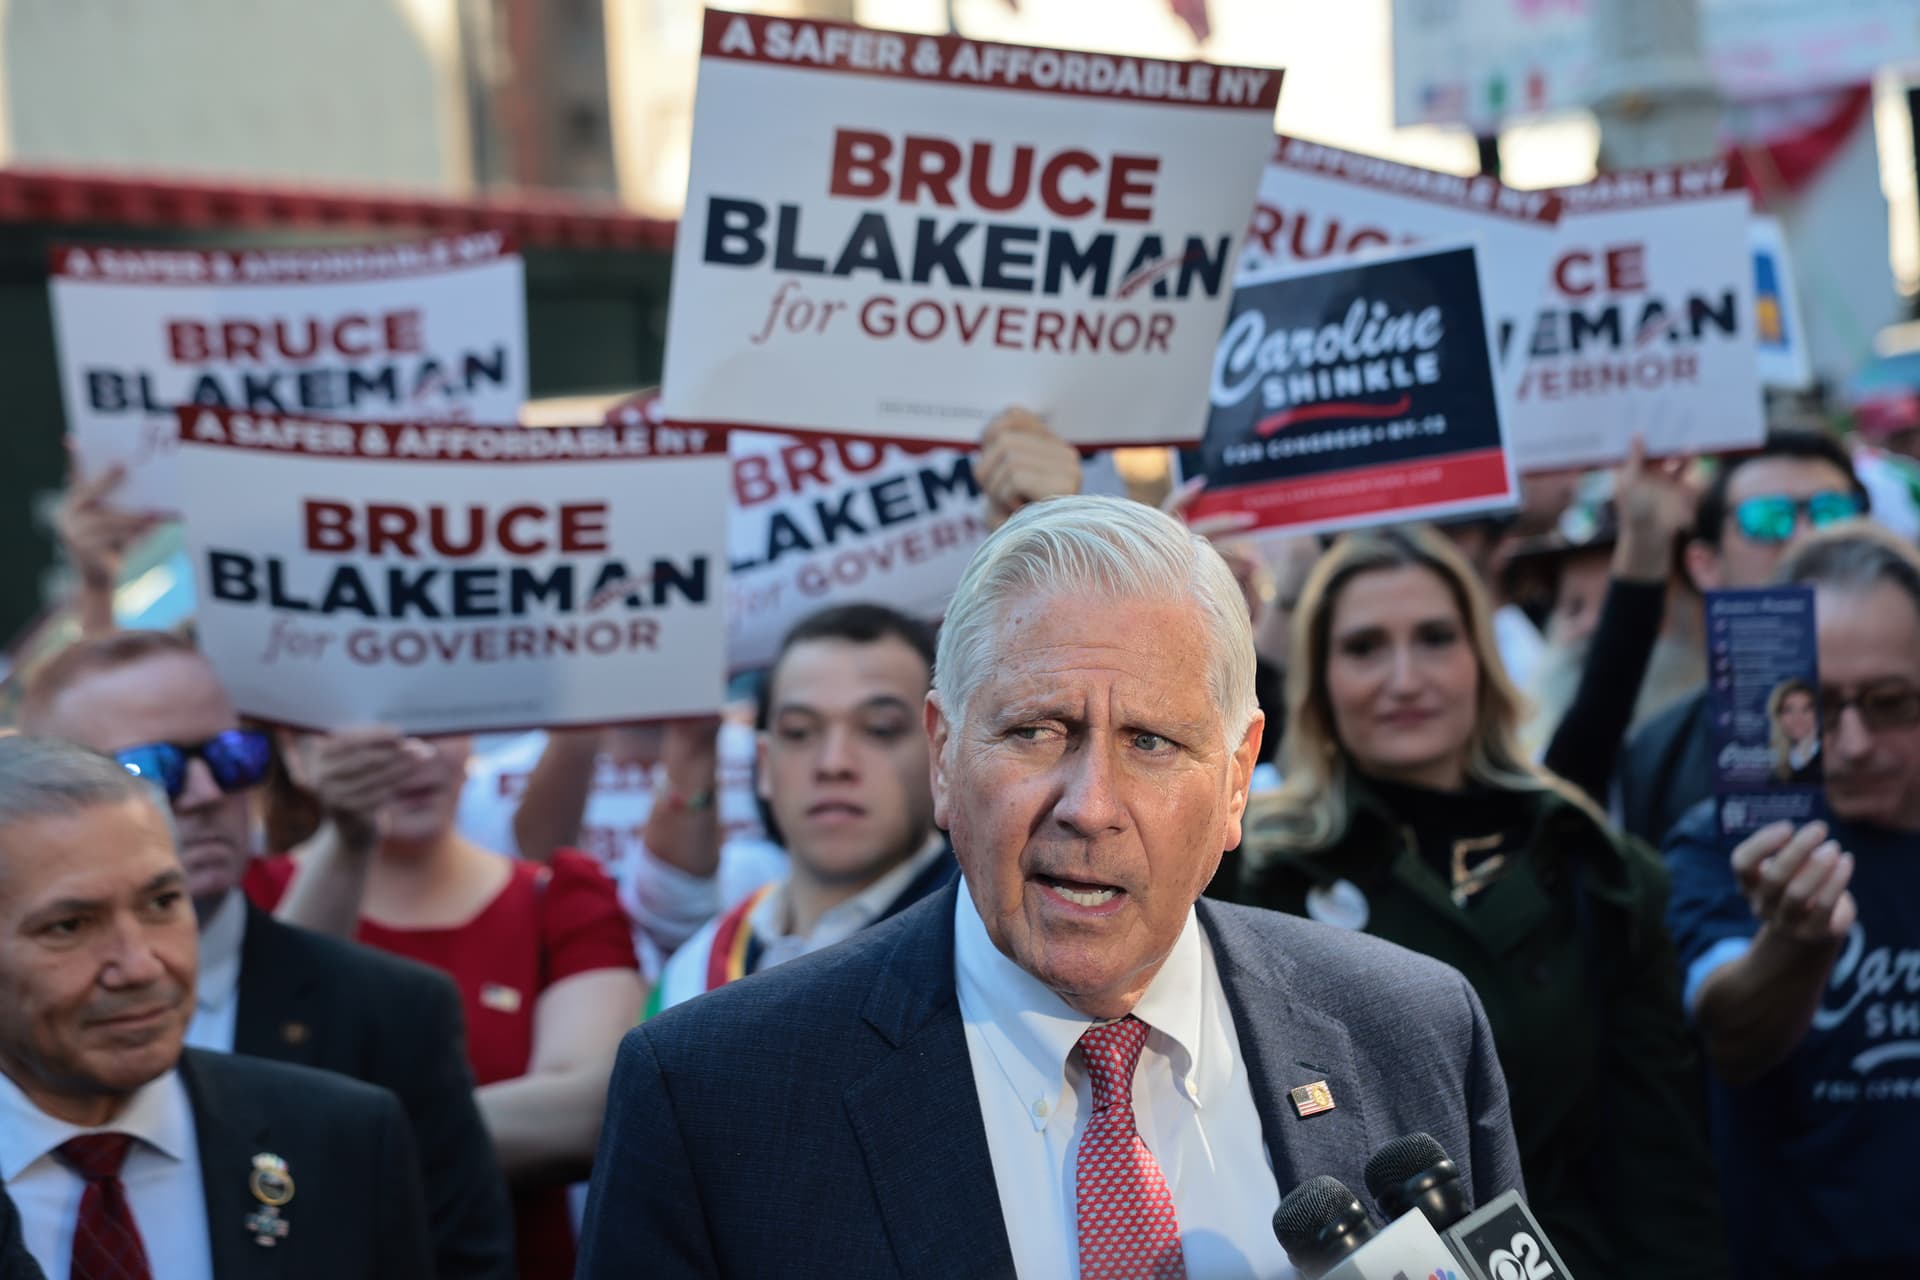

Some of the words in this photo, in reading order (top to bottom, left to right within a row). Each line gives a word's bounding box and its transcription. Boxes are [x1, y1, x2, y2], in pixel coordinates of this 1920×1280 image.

[719, 17, 756, 55] A
[764, 21, 905, 71] SAFER
[911, 38, 942, 75] &
[948, 43, 1215, 101] AFFORDABLE
[1216, 67, 1269, 104] NY
[829, 126, 1161, 223] BRUCE
[703, 197, 1231, 301] BLAKEMAN
[164, 309, 424, 364] BRUCE
[750, 280, 847, 345] for
[858, 296, 1177, 355] GOVERNOR
[1209, 296, 1446, 408] Caroline
[85, 347, 507, 415] BLAKEMAN
[1262, 352, 1441, 409] SHINKLE
[193, 409, 227, 442] A
[228, 413, 356, 455] SAFER
[359, 423, 391, 457] &
[393, 424, 650, 460] AFFORDABLE
[653, 426, 708, 452] NY
[303, 498, 608, 559] BRUCE
[207, 549, 709, 620] BLAKEMAN
[260, 617, 336, 666] for
[346, 618, 661, 667] GOVERNOR
